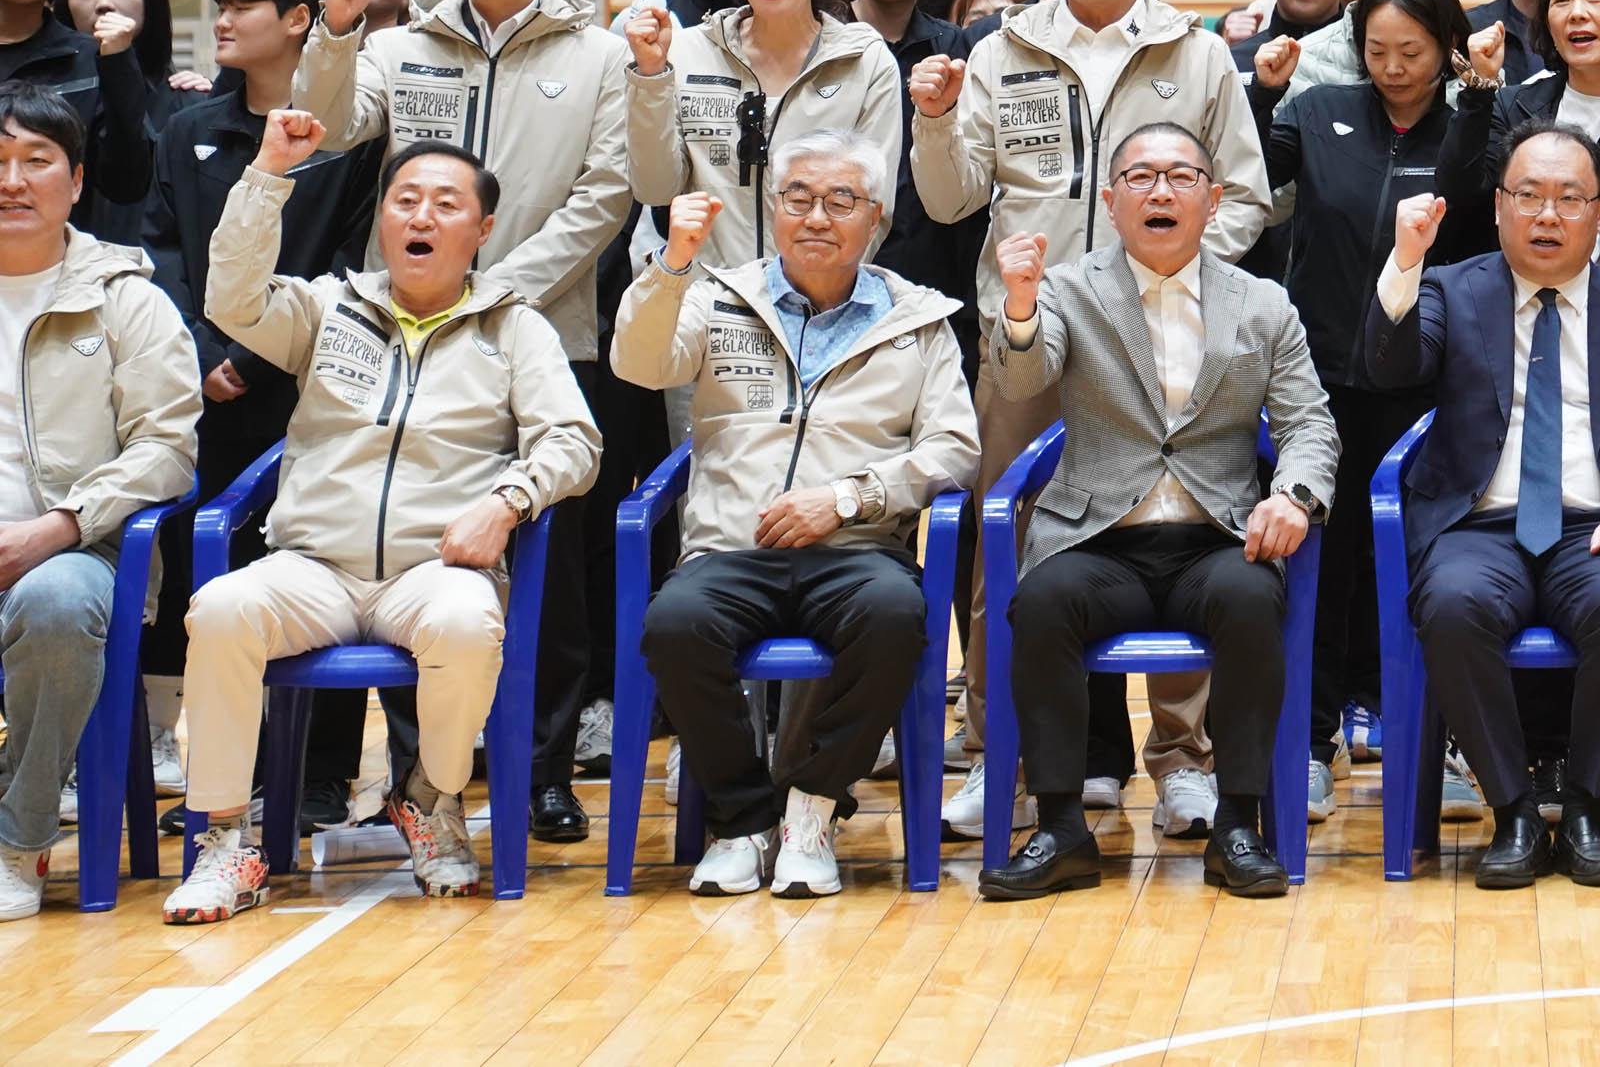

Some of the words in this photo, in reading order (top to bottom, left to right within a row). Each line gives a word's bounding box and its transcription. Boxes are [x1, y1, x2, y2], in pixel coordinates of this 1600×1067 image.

[408, 90, 460, 107] PATROUILLE
[691, 96, 737, 109] PATROUILLE
[1011, 96, 1059, 113] PATROUILLE
[405, 101, 459, 118] GLACIERS
[690, 106, 736, 118] GLACIERS
[1011, 108, 1061, 126] GLACIERS
[394, 125, 453, 139] PDG
[684, 128, 732, 136] PDG
[1005, 133, 1060, 149] PDG
[723, 328, 775, 344] PATROUILLE
[337, 329, 383, 363] PATROUILLE
[722, 339, 776, 356] GLACIERS
[332, 339, 382, 371] GLACIERS
[316, 362, 377, 385] PDG
[714, 366, 774, 376] PDG
